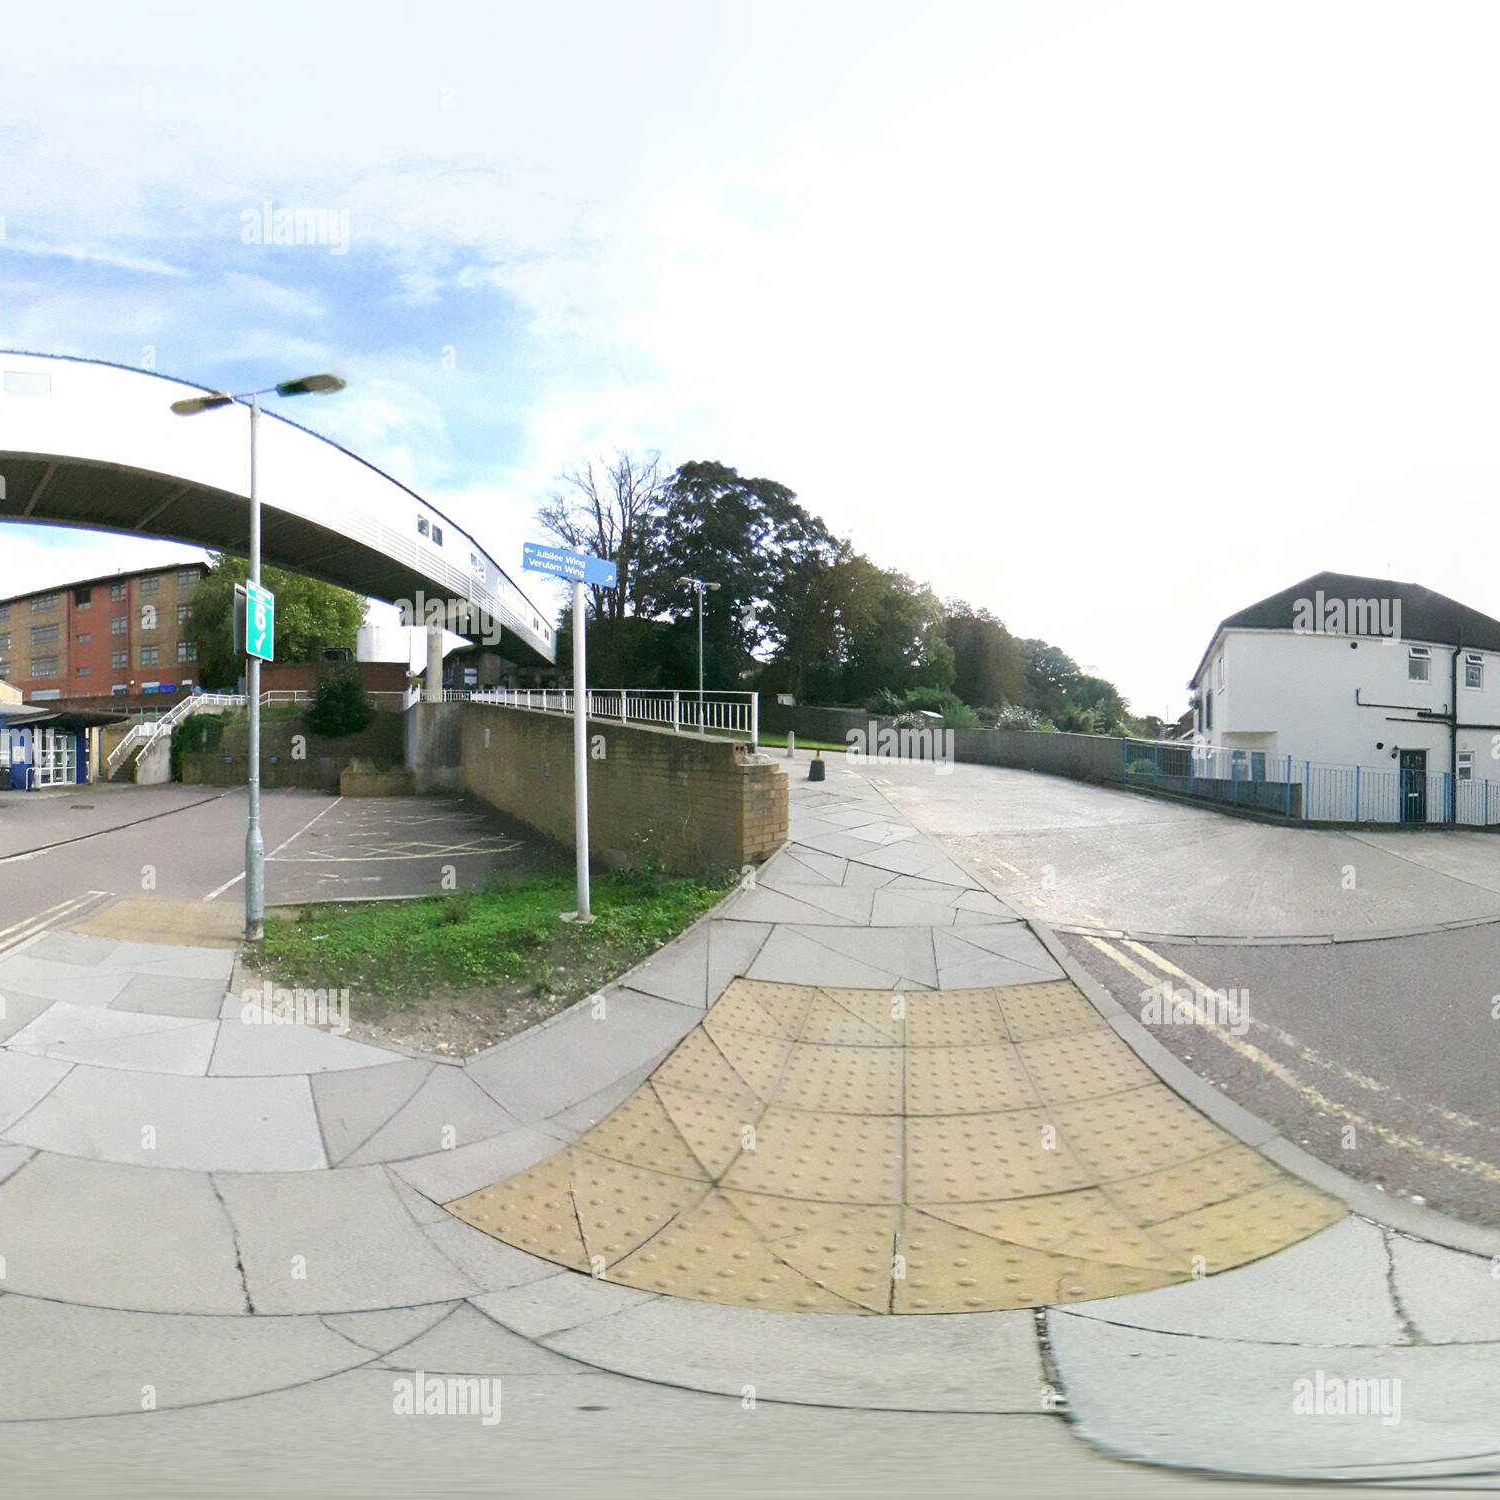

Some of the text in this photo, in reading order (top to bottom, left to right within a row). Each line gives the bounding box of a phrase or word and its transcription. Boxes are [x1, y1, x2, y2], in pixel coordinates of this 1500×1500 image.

[528, 557, 585, 577] Verulam Wing
[536, 549, 586, 569] Jubilee Wing
[254, 604, 267, 631] 6
